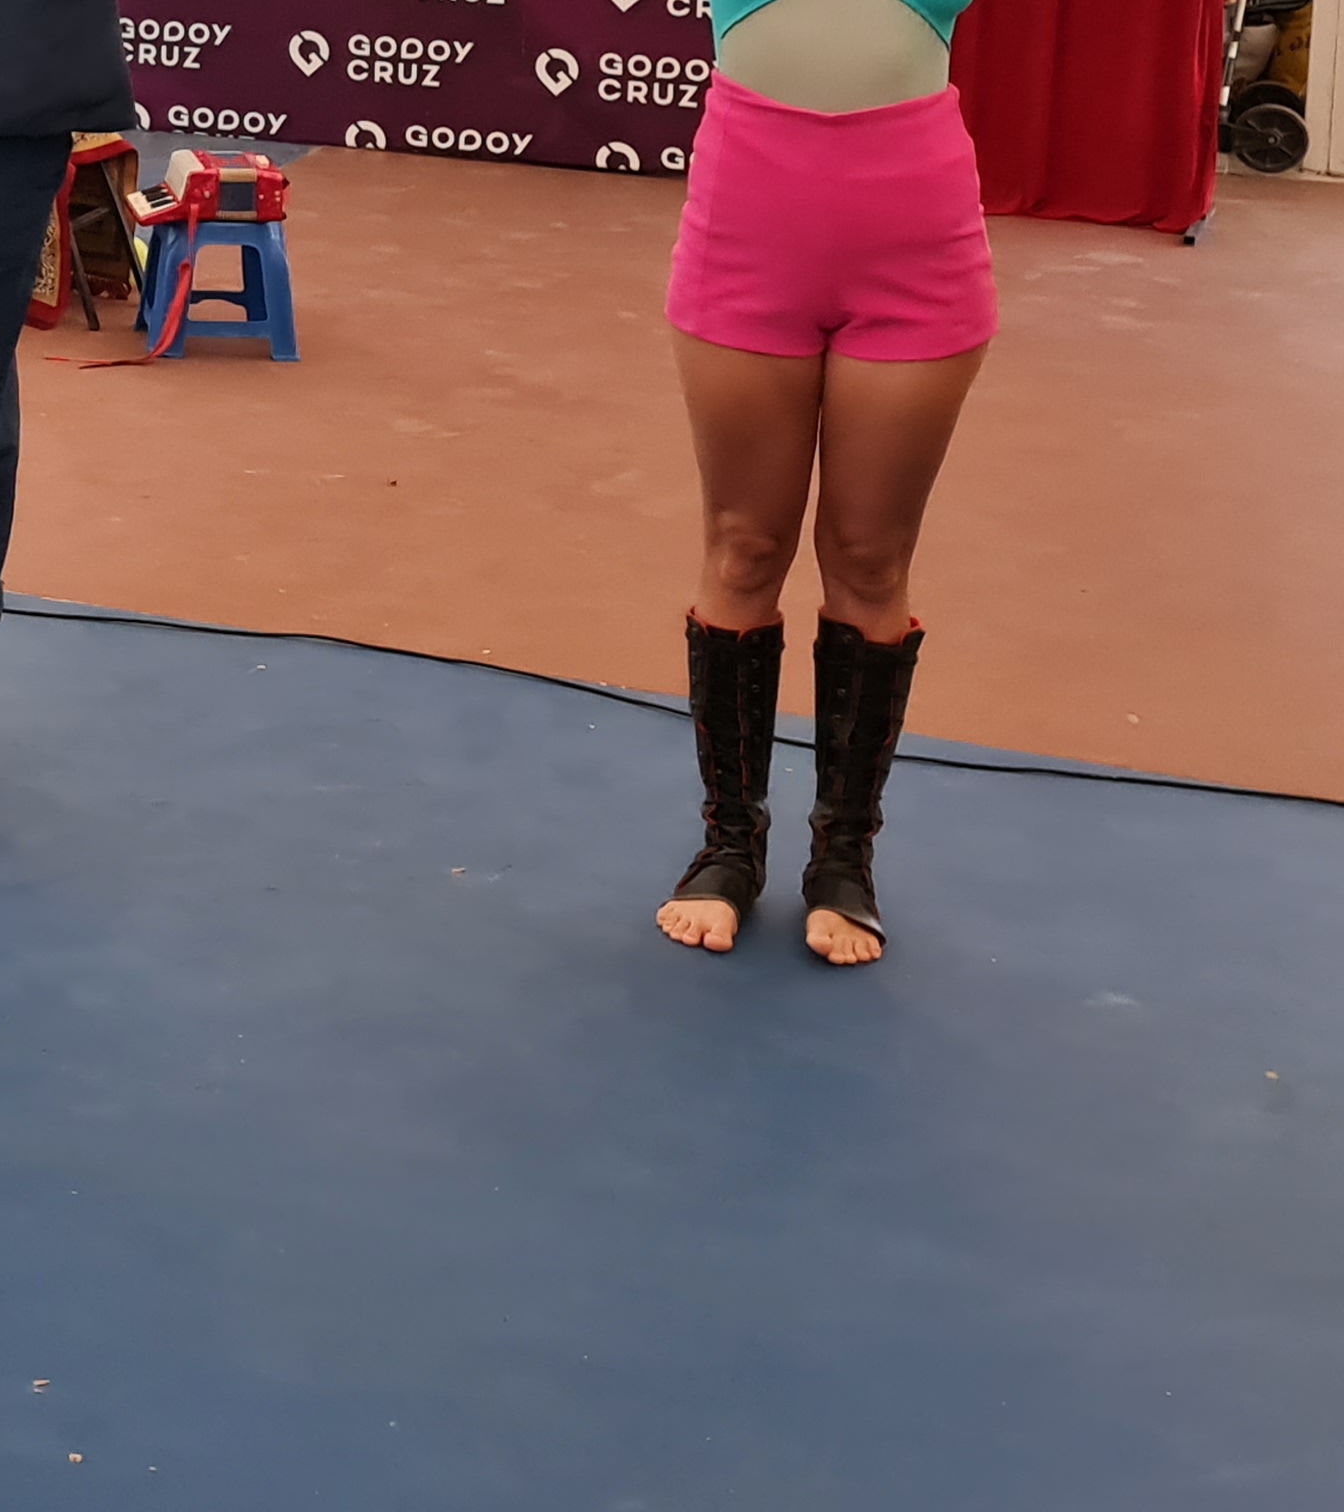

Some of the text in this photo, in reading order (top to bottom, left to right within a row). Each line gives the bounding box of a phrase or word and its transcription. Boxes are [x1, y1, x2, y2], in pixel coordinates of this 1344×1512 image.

[119, 17, 232, 47] GODOY
[348, 34, 475, 64] GODOY
[346, 59, 441, 87] CRUZ
[599, 52, 710, 83] GODO
[597, 78, 699, 108] CRUZ
[167, 105, 288, 136] GODOY
[405, 125, 534, 156] GODOY
